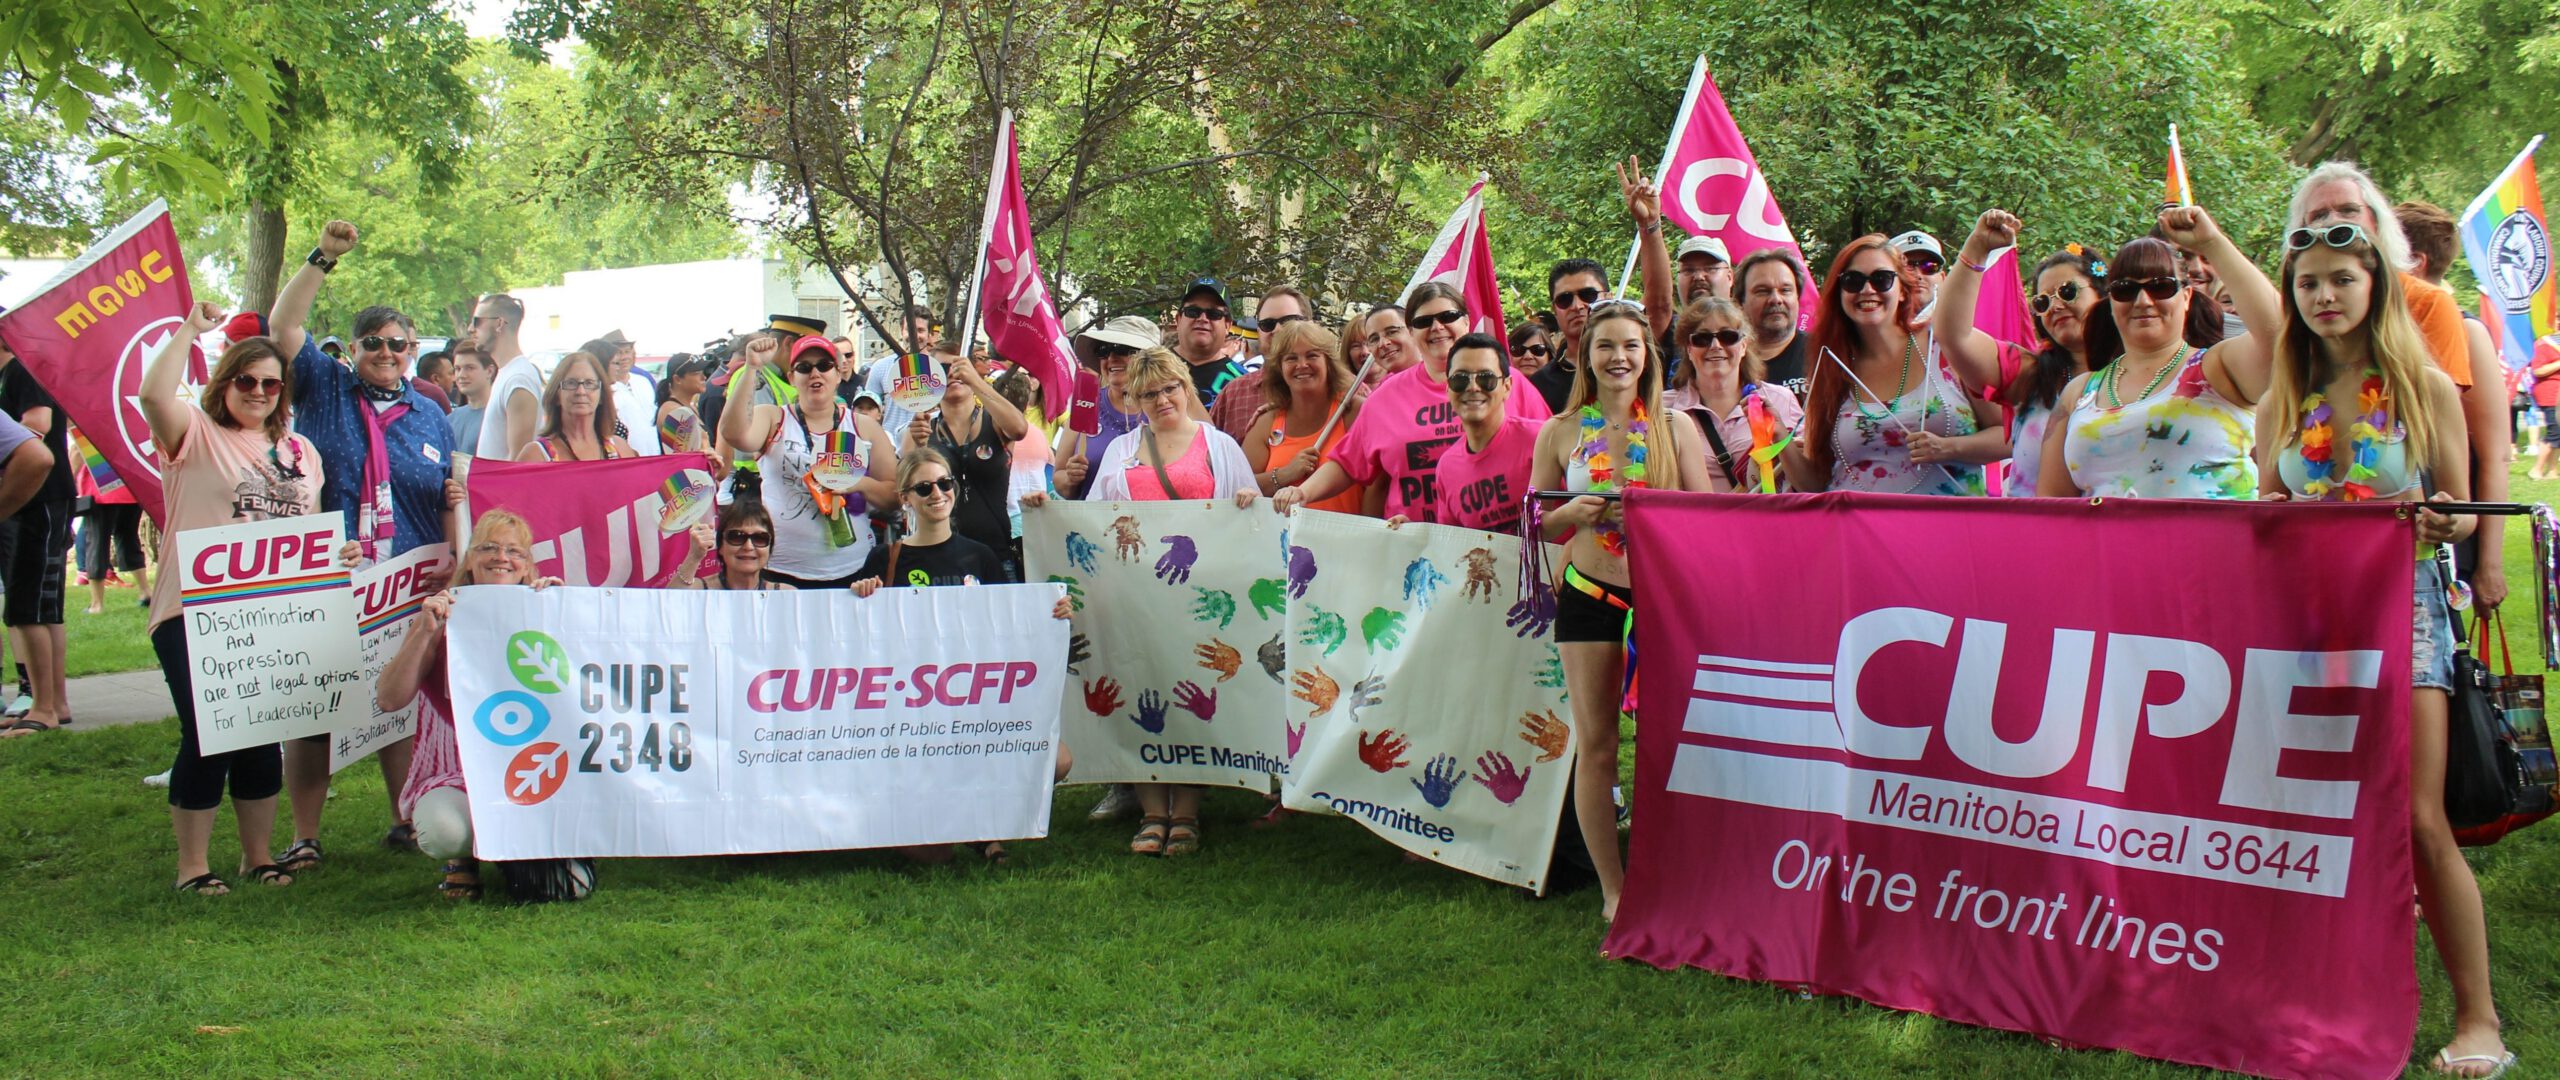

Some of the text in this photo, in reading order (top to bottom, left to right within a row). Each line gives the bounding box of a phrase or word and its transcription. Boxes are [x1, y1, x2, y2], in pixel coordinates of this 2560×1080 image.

[54, 249, 174, 339] USGE
[893, 373, 941, 393] FIERS
[1783, 378, 1807, 386] LOC
[1076, 399, 1095, 409] SCFP
[816, 452, 863, 469] FIERS
[1460, 474, 1509, 514] CUPE
[192, 529, 334, 585] CUPE
[196, 602, 325, 636] Discimination
[226, 633, 255, 650] And
[360, 635, 380, 651] Law
[202, 649, 311, 680] Oppression
[204, 670, 360, 703] are not legal options
[579, 663, 690, 714] CUPE
[213, 707, 236, 731] For
[1834, 607, 2384, 819] CUPE
[355, 710, 412, 749] Solidarity
[753, 719, 1033, 742] Canadian Union of Public Employees
[578, 722, 692, 773] 2348
[737, 739, 1050, 767] Syndicat canadien de la fonction publique
[1140, 743, 1207, 765] CUPE
[1868, 778, 2321, 882] Manitoba Local 3644
[1933, 869, 2067, 940] front
[2075, 895, 2224, 972] lines
